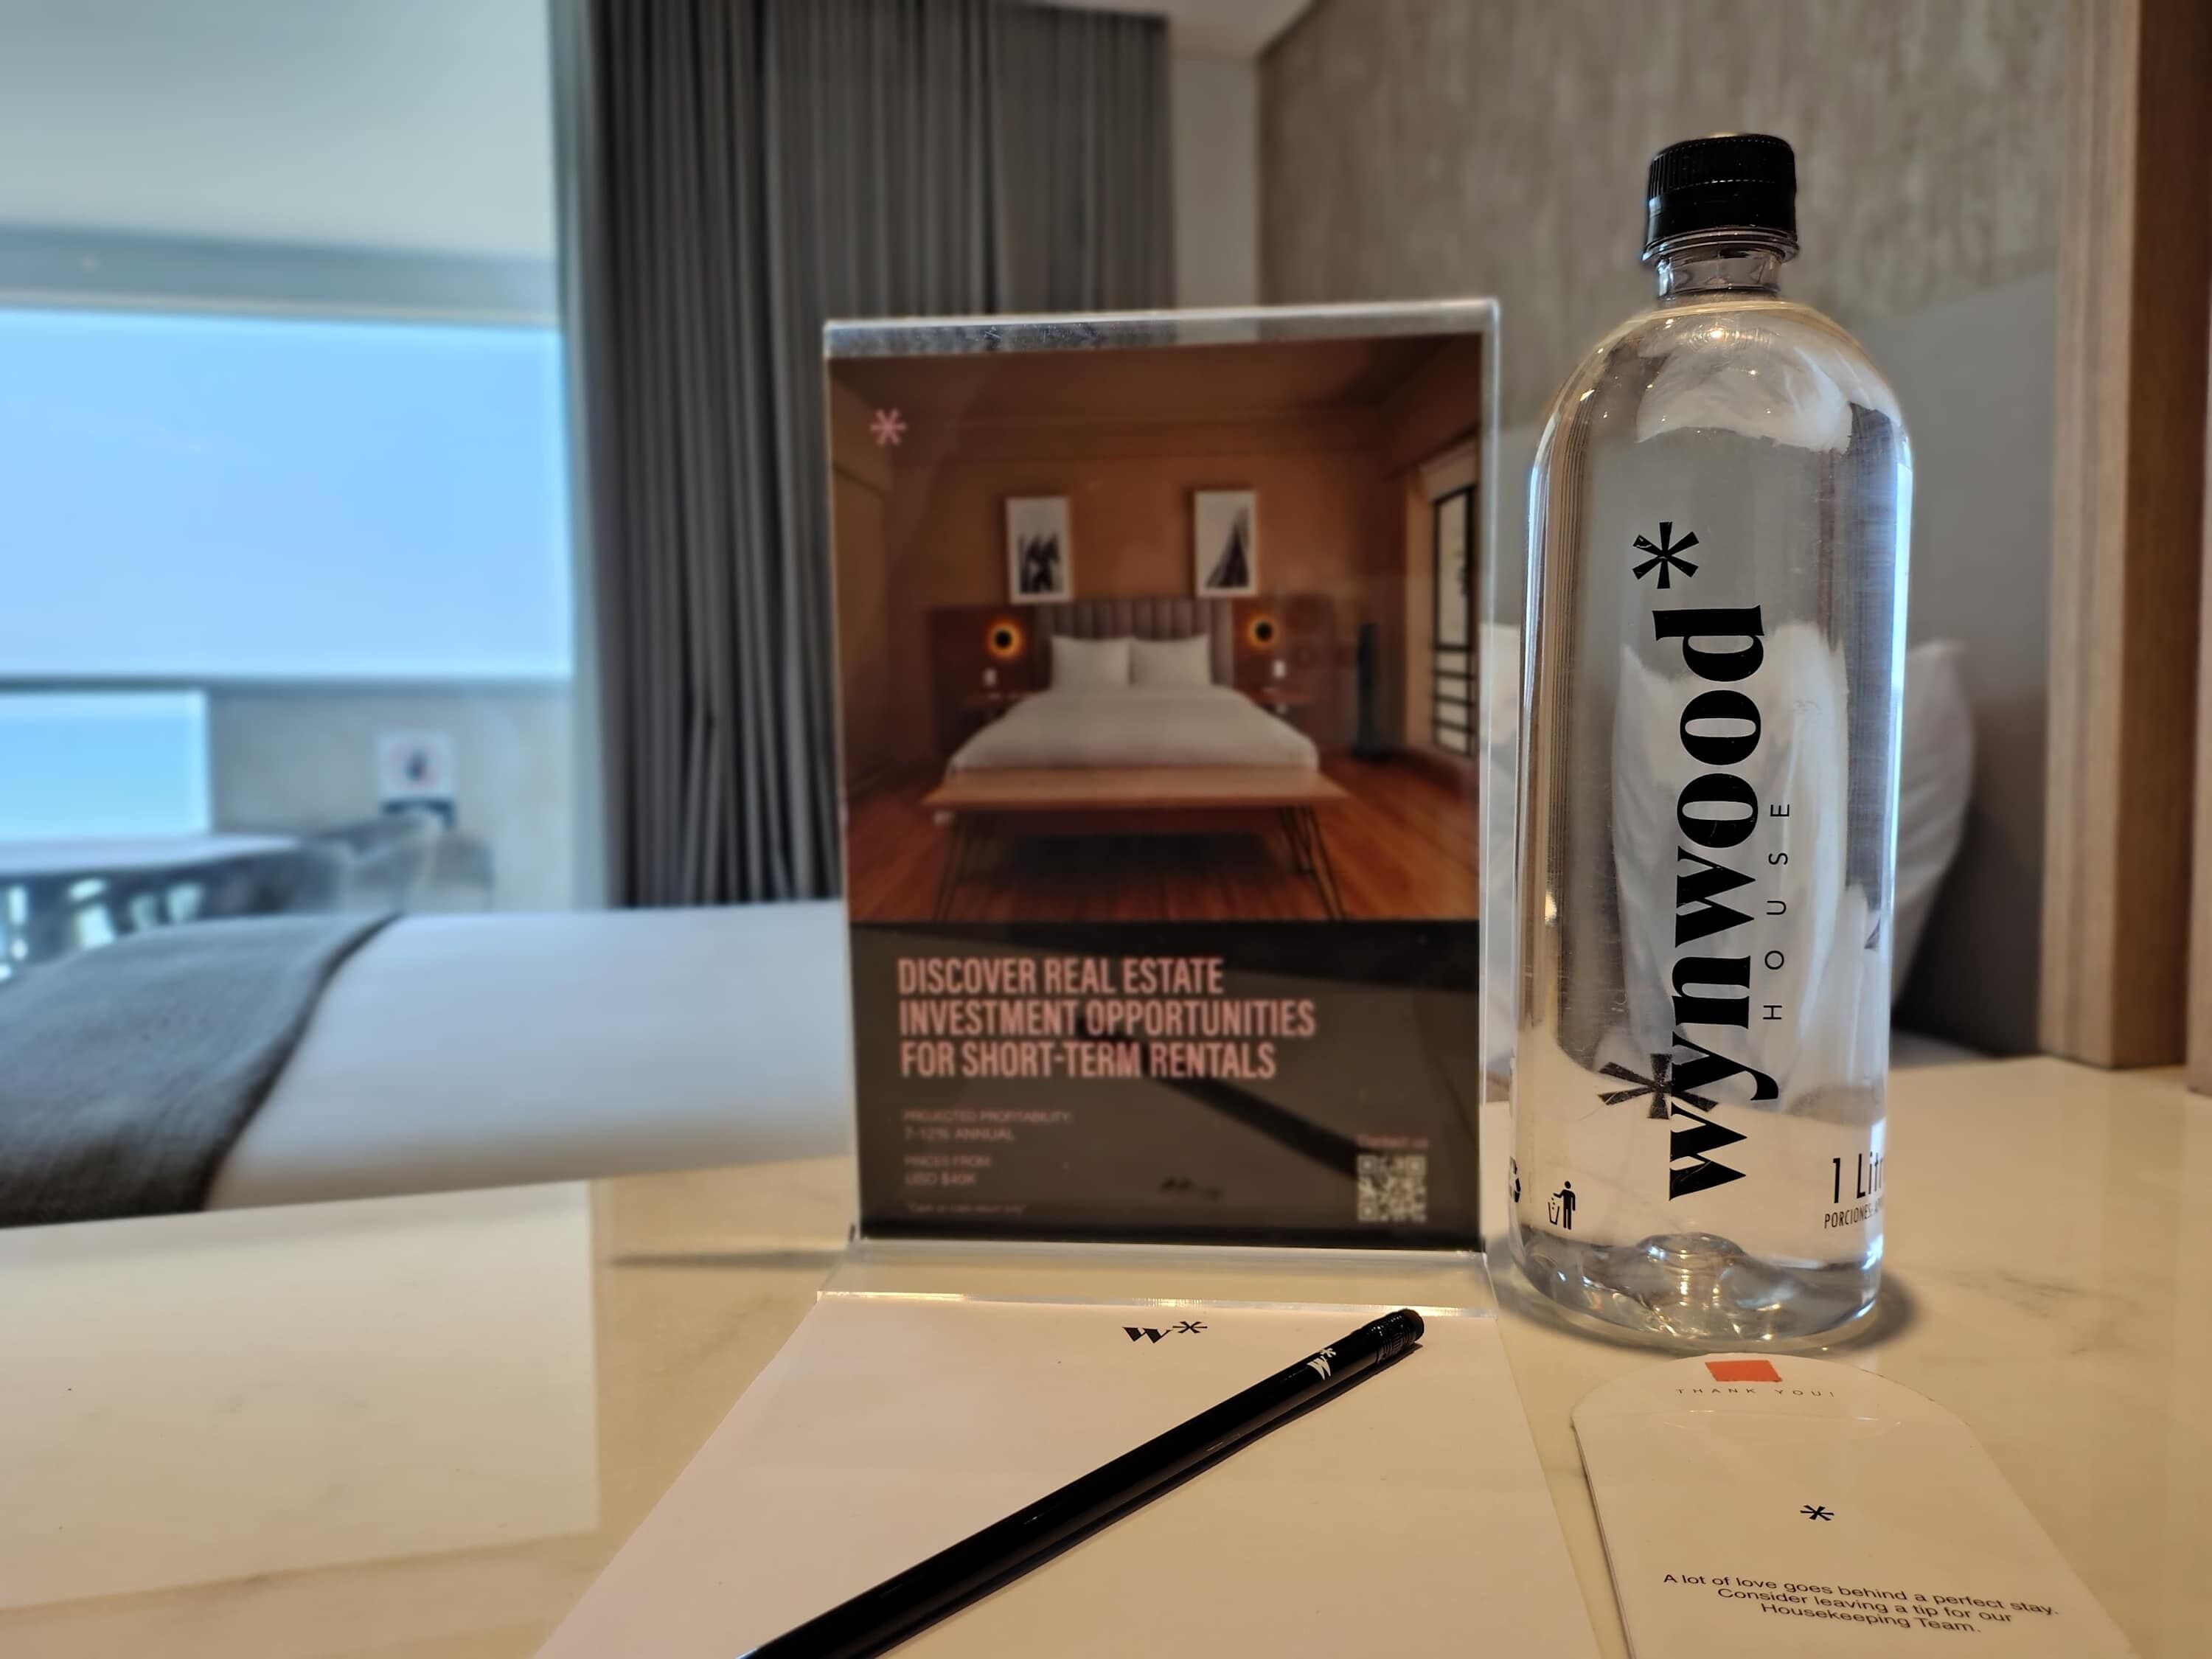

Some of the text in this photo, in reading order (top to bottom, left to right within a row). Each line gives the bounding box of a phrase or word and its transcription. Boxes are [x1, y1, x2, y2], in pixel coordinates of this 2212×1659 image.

[1652, 605, 1778, 1200] wynwood
[1762, 804, 1790, 1020] HOUSE
[897, 956, 1224, 995] DISCOVER REAL ESTATE
[899, 998, 1317, 1037] INVESTMENT OPPORTUNITIES
[901, 1040, 1276, 1079] FOR SHORT-TERM RENTALS
[1832, 1157, 1840, 1203] 1
[1663, 1574, 2059, 1616] A lot of love goes behind a perfect stay.
[1717, 1587, 2012, 1623] Consider leaving a tip for our
[1761, 1603, 1982, 1633] Housekeeping Team.
